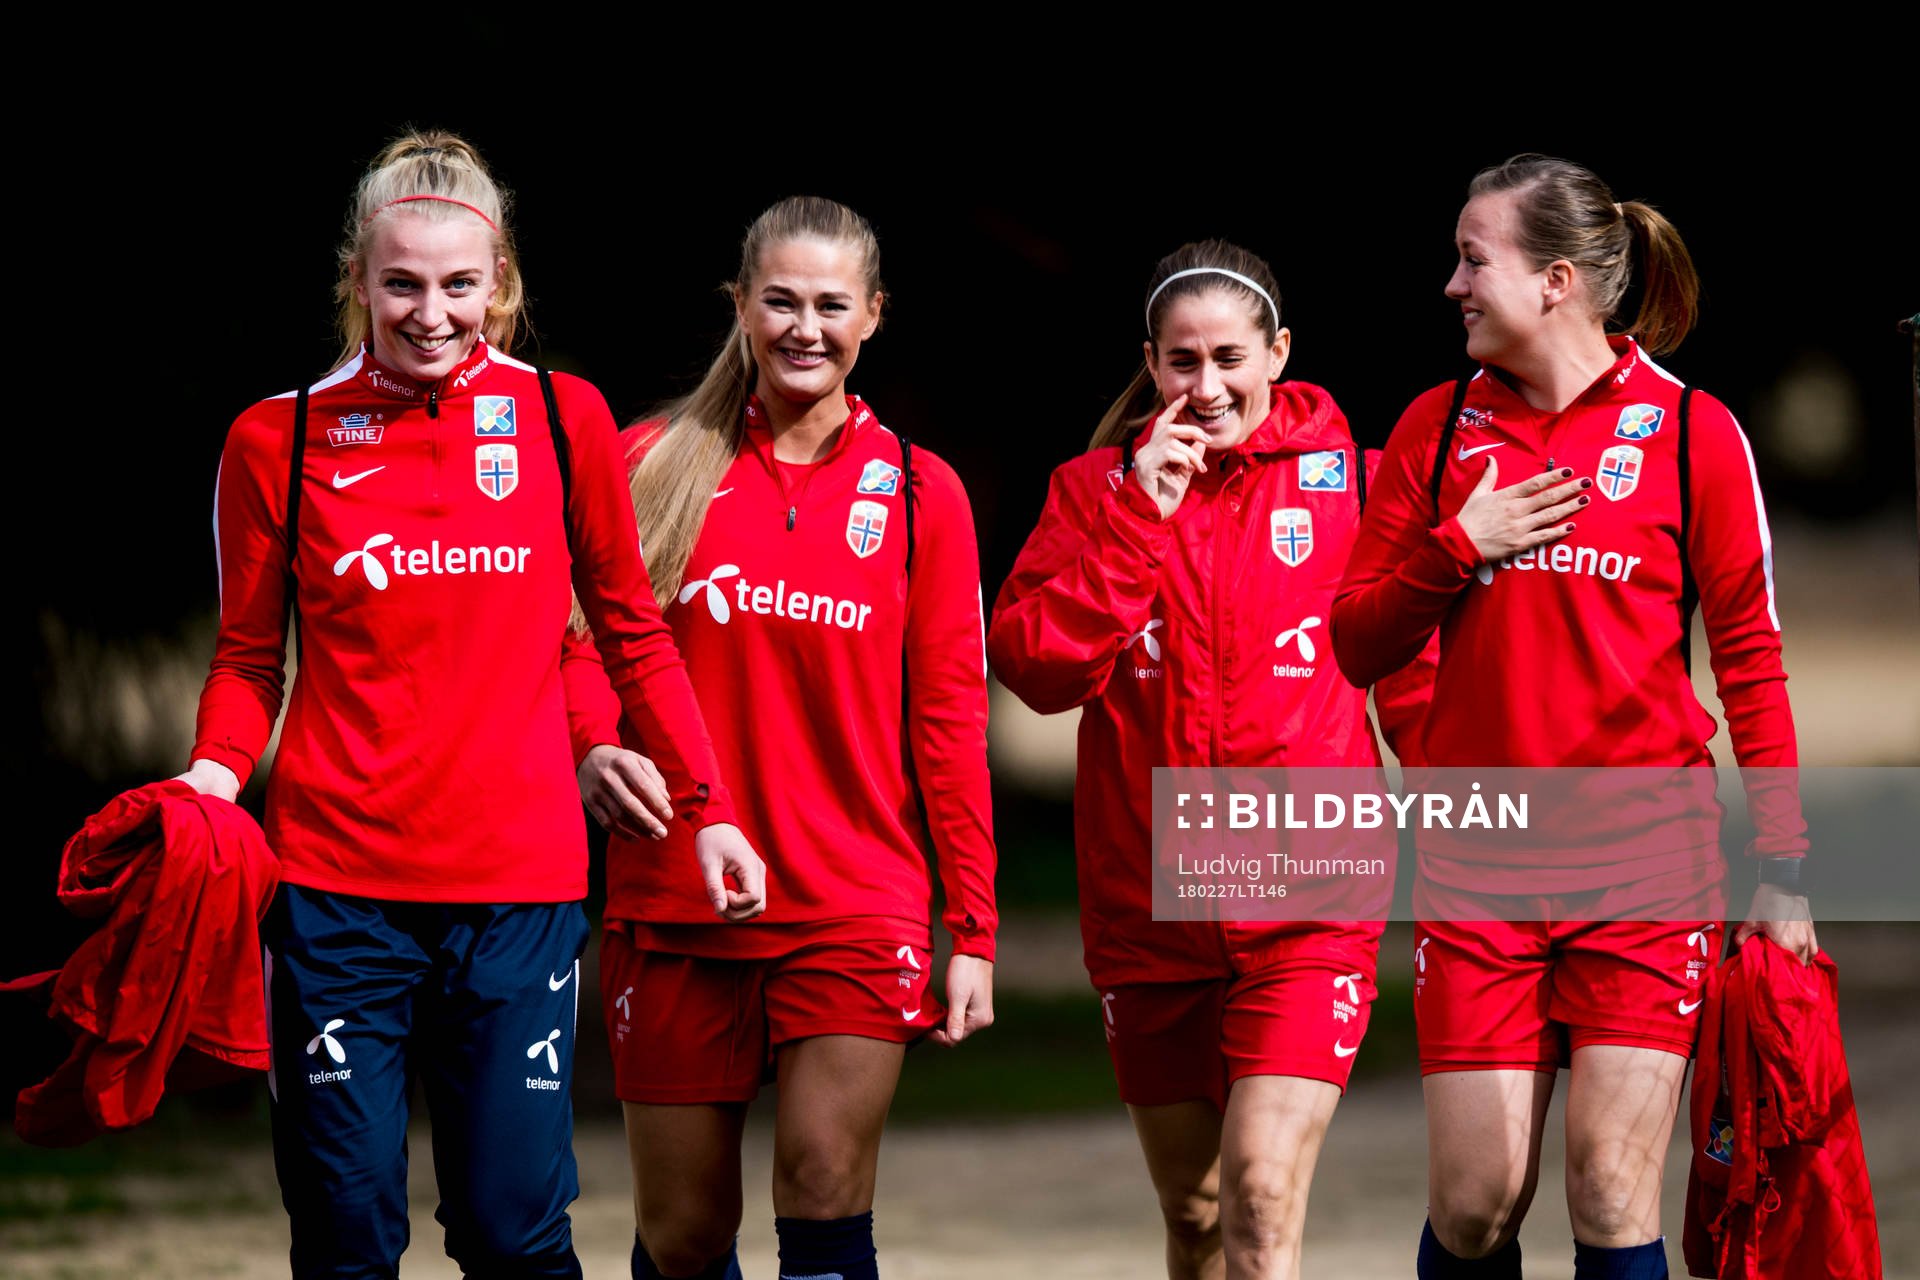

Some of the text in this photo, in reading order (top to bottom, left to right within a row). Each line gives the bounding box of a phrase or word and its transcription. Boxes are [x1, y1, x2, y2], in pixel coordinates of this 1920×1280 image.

[379, 377, 416, 397] telenor
[333, 429, 376, 441] TINE
[390, 540, 531, 575] telenor
[735, 578, 872, 631] telenor
[1272, 663, 1316, 678] telenor
[1332, 1009, 1349, 1023] yng
[1333, 999, 1358, 1017] telenor
[308, 1068, 352, 1084] telenor
[525, 1077, 561, 1091] telenor
